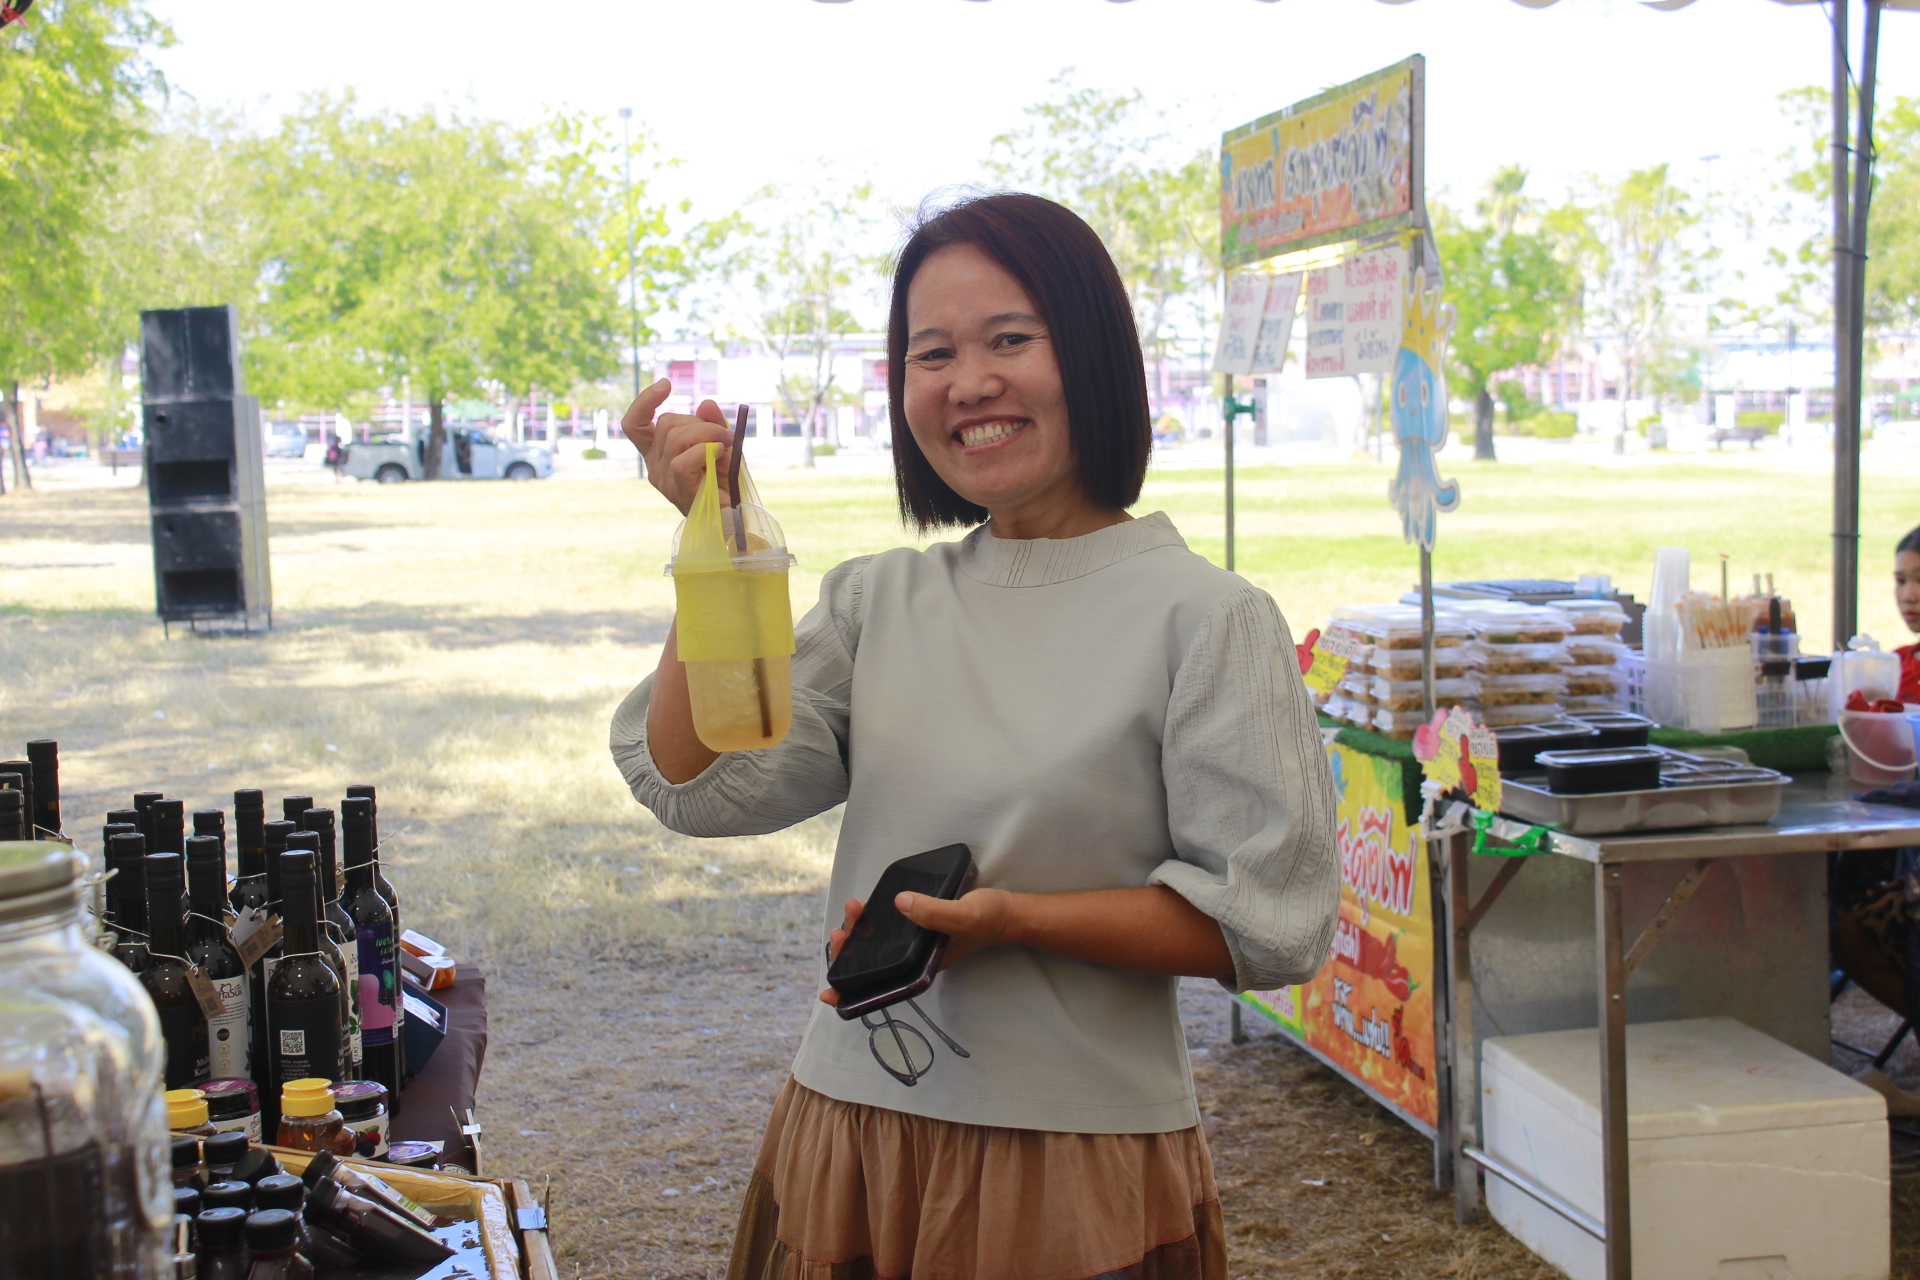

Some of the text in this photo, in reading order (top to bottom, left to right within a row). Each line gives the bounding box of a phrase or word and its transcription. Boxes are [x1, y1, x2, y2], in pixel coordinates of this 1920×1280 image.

[1319, 639, 1358, 656] ขายดี
[1469, 736, 1496, 756] ขายดี
[217, 987, 244, 999] haSuk
